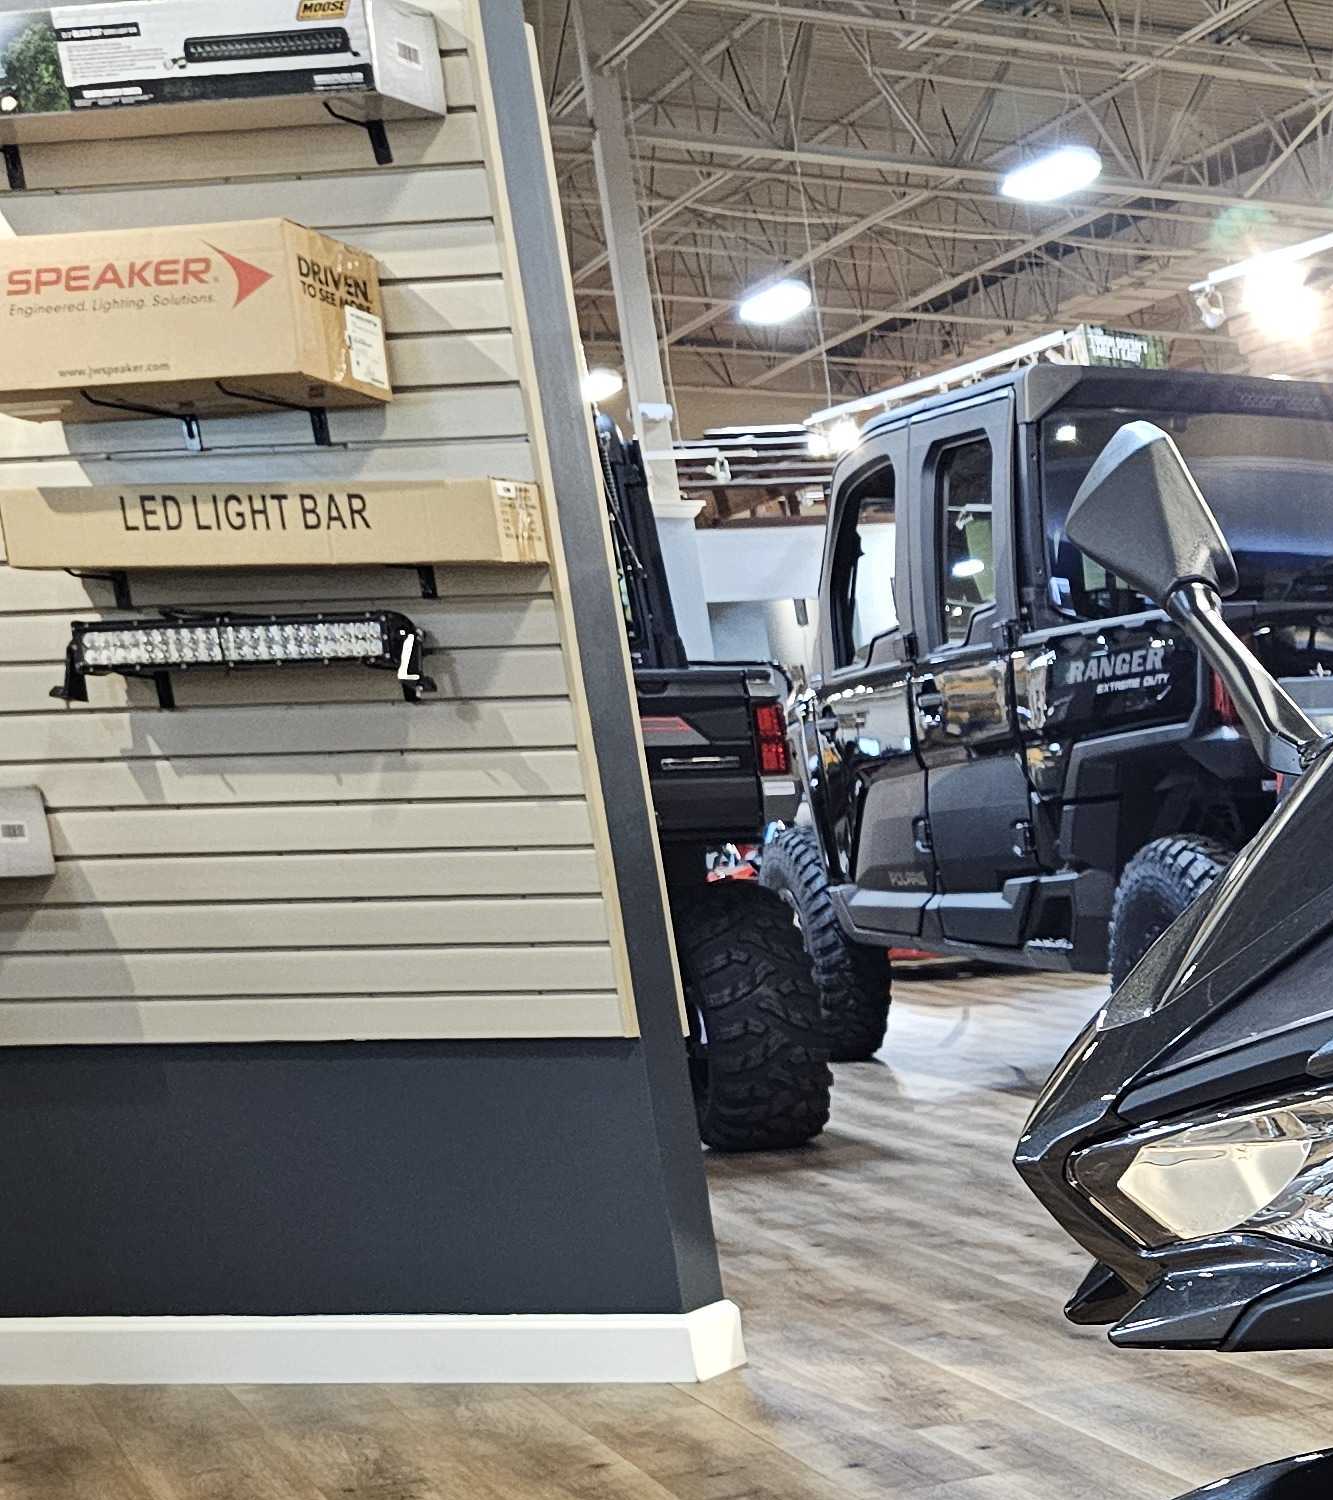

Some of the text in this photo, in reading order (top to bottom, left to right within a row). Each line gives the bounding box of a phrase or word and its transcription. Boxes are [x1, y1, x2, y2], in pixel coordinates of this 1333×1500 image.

[6, 257, 212, 296] SPEAKER
[300, 280, 317, 298] TO
[319, 288, 337, 307] SEE
[58, 362, 170, 378] www.jwspeaker.com
[119, 493, 372, 531] LED LIGHT BAR
[1065, 648, 1165, 684] RANGER
[1143, 673, 1170, 687] DUTY
